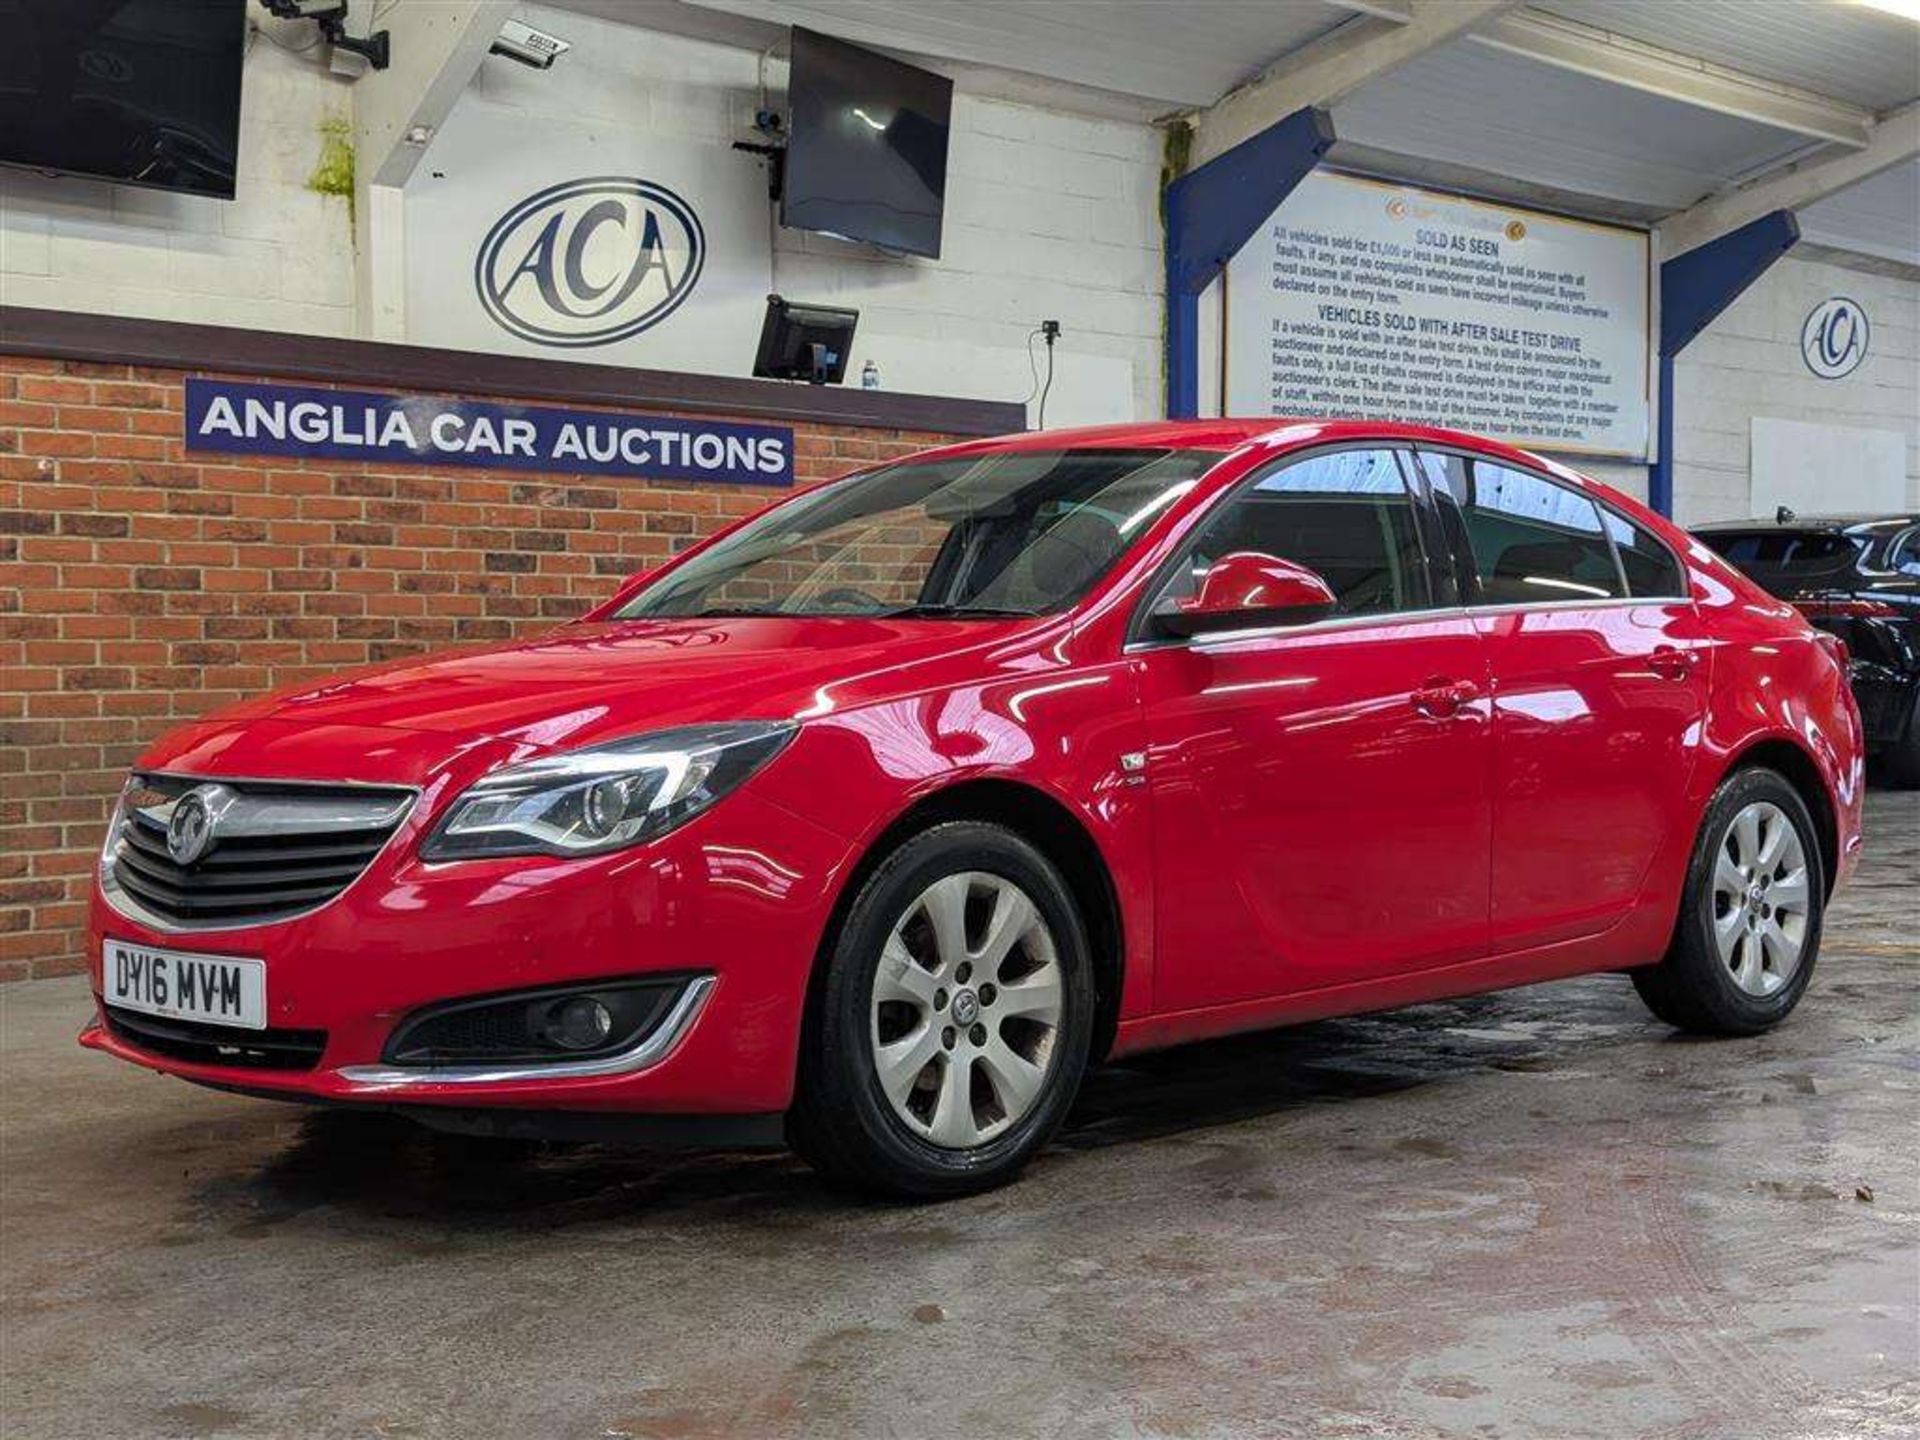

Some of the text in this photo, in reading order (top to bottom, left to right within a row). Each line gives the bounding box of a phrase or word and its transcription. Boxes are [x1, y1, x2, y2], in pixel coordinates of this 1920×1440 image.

[498, 200, 676, 318] ACA
[1416, 229, 1499, 257] SOLD AS SEEN
[1318, 305, 1581, 352] VEHICLES SOLD WITH AFTER SALE TEST DRIVE
[1807, 307, 1861, 367] ACA
[199, 396, 786, 473] ANGLIA CAR AUCTIONS
[116, 949, 242, 1017] DY16 MVM
